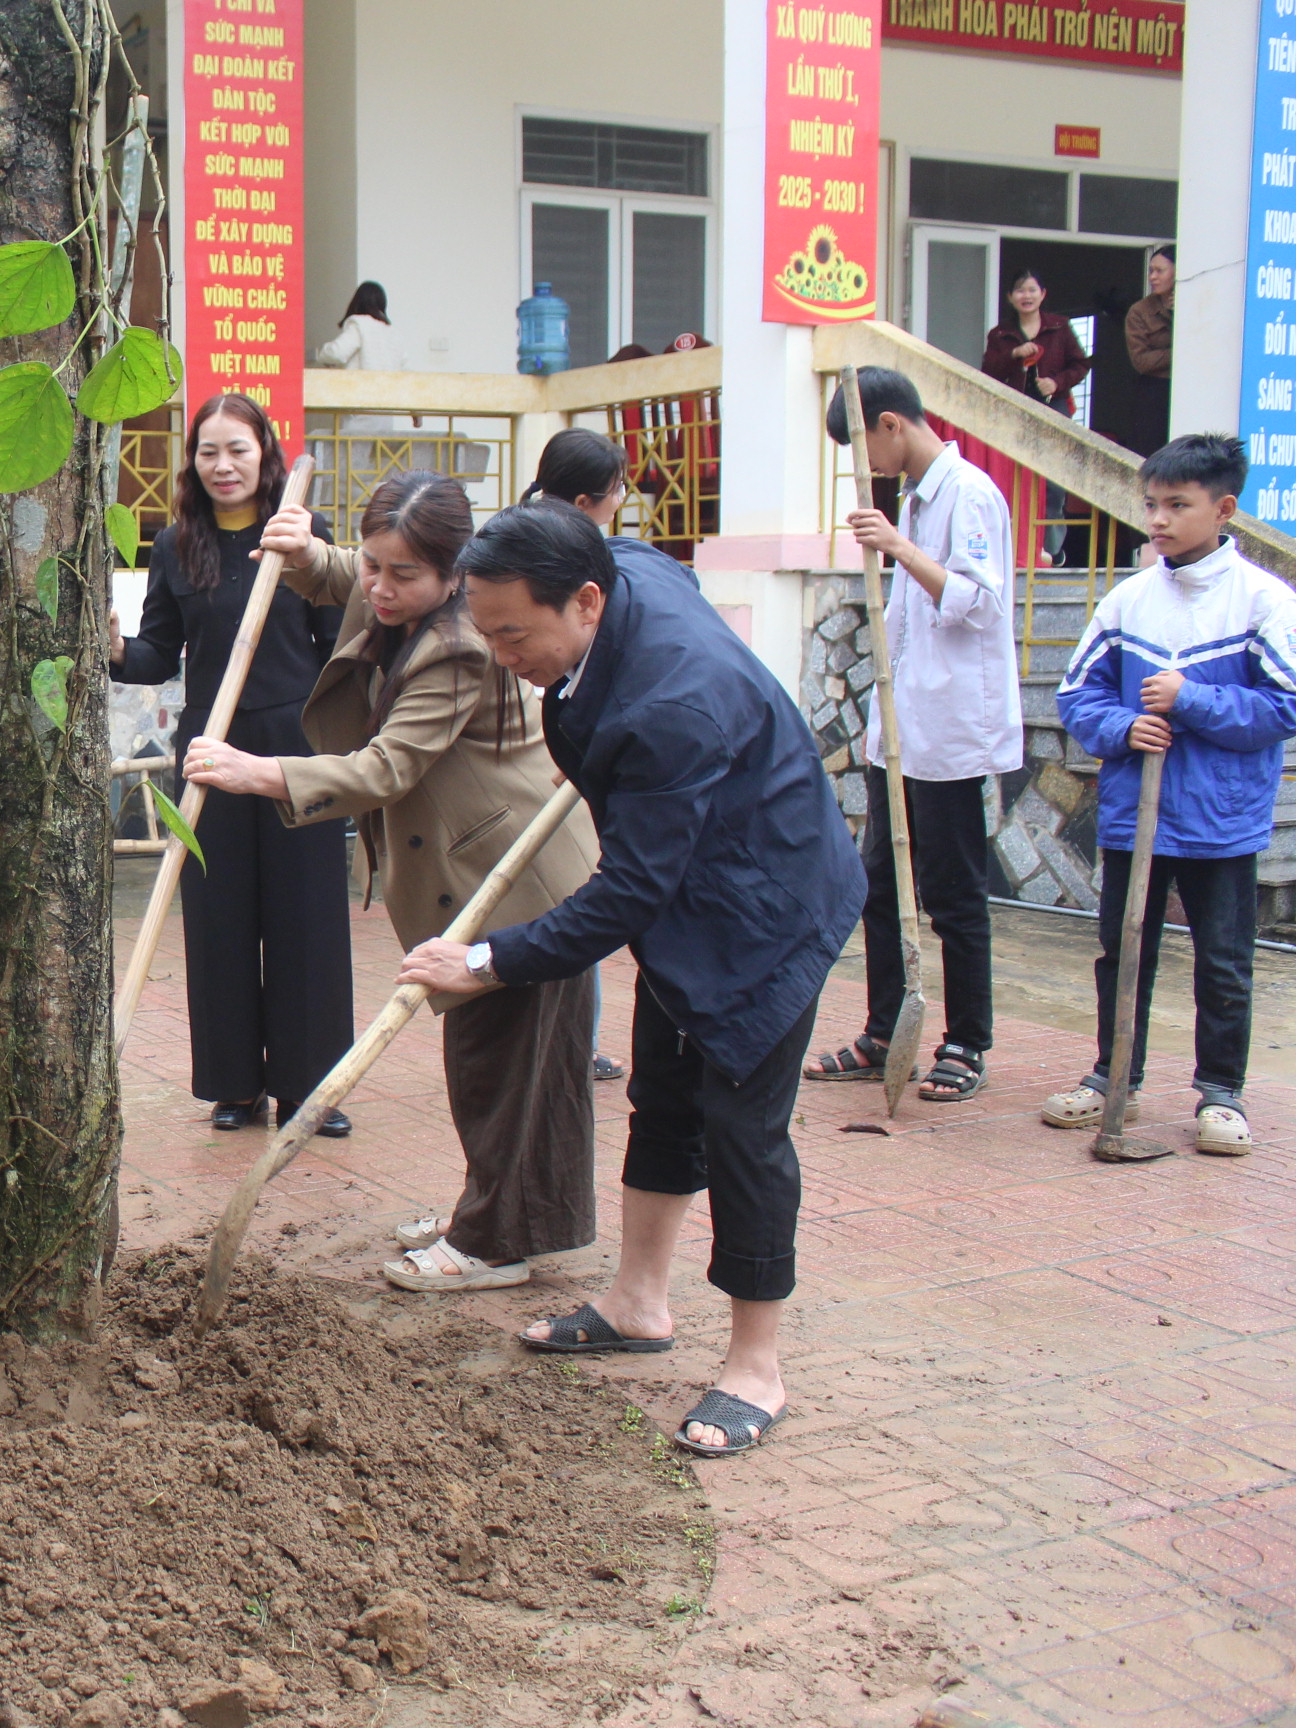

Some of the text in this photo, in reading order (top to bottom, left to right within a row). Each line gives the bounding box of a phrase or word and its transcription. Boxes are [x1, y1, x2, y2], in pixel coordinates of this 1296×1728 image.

[205, 19, 283, 49] SỨC MẠNH
[777, 1, 871, 48] XÃ QUÝ LƯƠNG
[890, 0, 953, 31] THANH
[1054, 0, 1090, 48] TRỞ
[1093, 7, 1133, 53] NÊN
[1136, 13, 1178, 64] MỘT
[193, 54, 295, 81] ĐẠI ĐOÀN KẾT
[788, 54, 814, 96] LẦN
[818, 63, 844, 101] THỨ
[213, 86, 275, 115] DÂN TỘC
[200, 117, 289, 148] KẾT HỢP VỚI
[790, 116, 854, 160] NHIỆM KỲ
[205, 152, 283, 181] SỨC MẠNH
[1263, 148, 1296, 187] PHÁT
[213, 185, 275, 214] THỜI ĐẠI
[779, 175, 811, 208] 2025
[824, 180, 856, 213] 2030
[196, 214, 292, 247] ĐỂ XÂY DỰNG
[209, 250, 284, 280] VÀ BẢO VỆ
[1257, 260, 1292, 300] CÔNG
[204, 283, 286, 310] VỮNG CHẮC
[214, 314, 276, 343] TỔ QUỐC
[1265, 311, 1287, 355] ĐỔI
[211, 350, 280, 377] VIỆT NAM
[1258, 372, 1292, 411] SÁNG
[1250, 427, 1266, 465] VÀ
[1258, 477, 1279, 521] ĐỔI
